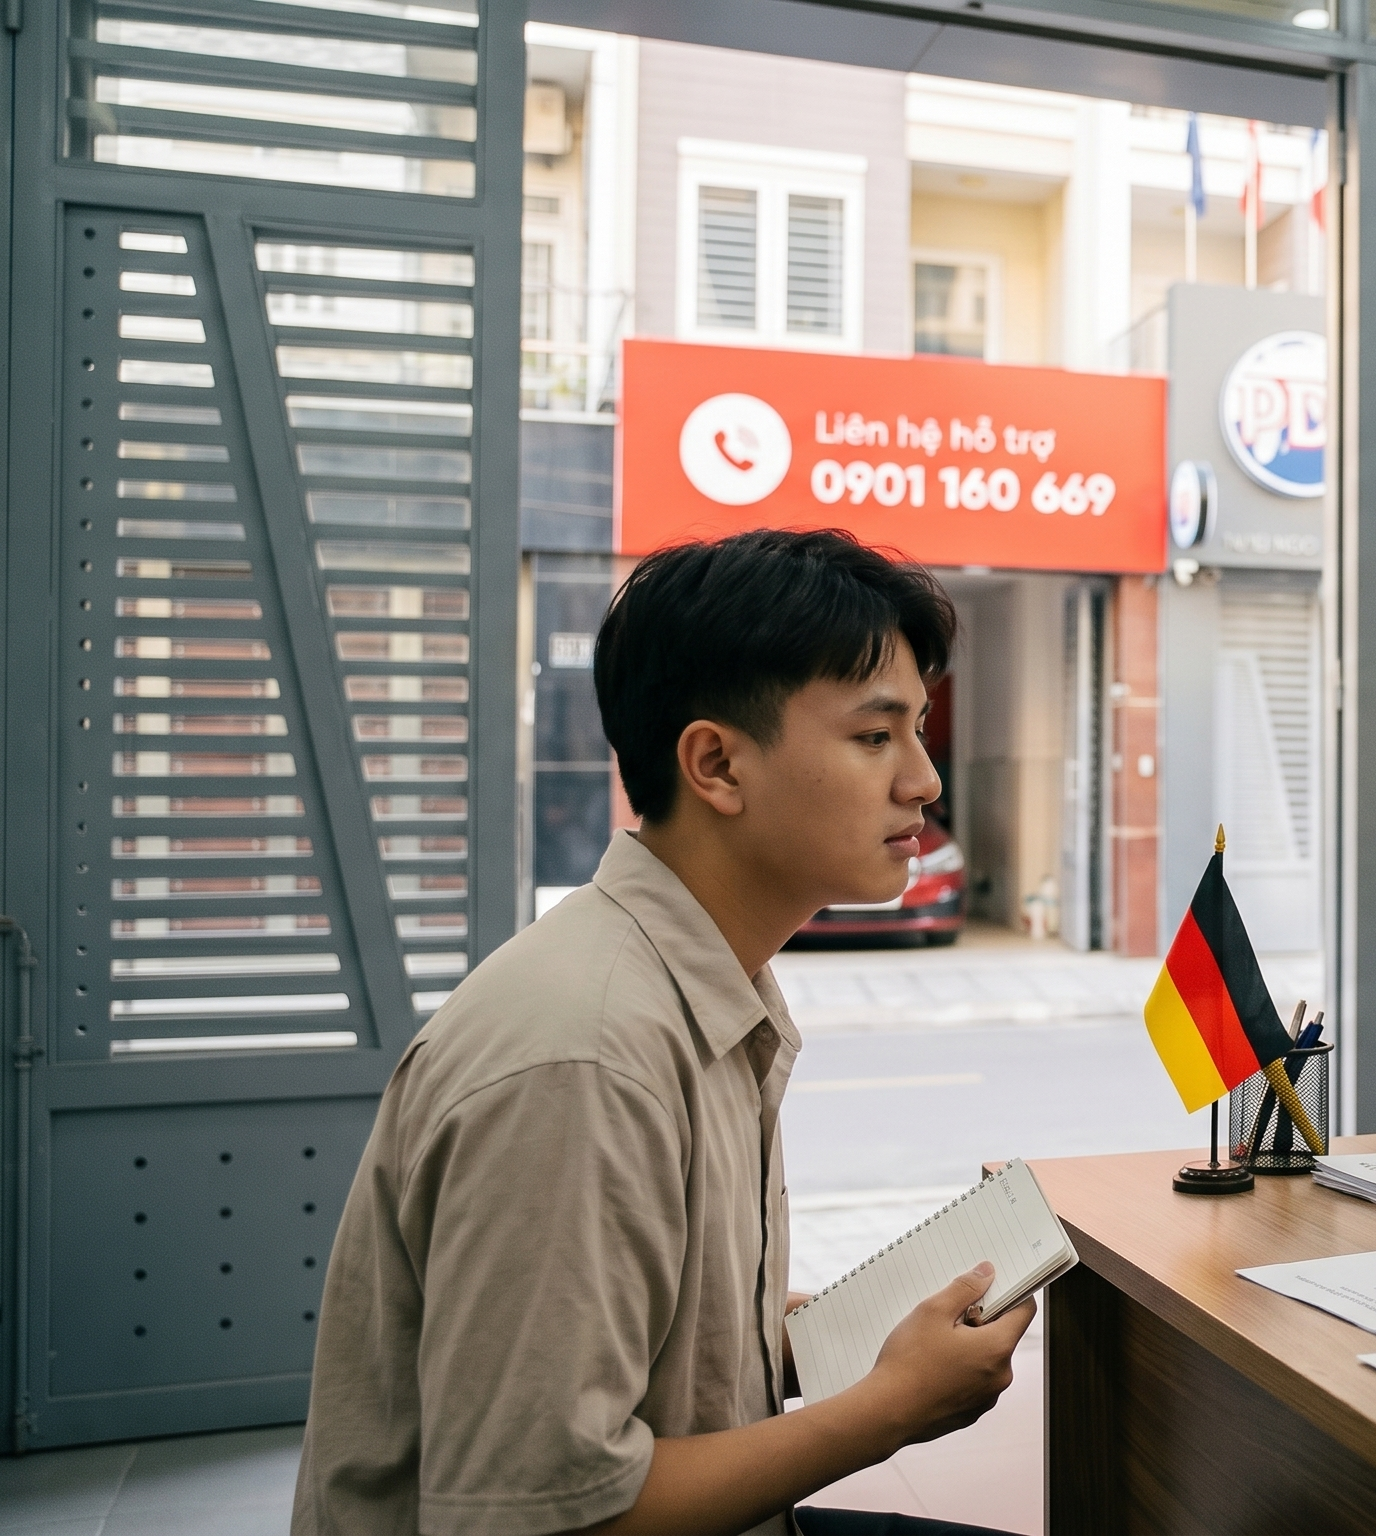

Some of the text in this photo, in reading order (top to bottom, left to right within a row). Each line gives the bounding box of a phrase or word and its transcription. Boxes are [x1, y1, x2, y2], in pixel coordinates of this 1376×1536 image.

[815, 410, 1056, 463] Liên hệ hỗ trợ
[810, 459, 1117, 516] 0901 160 669
